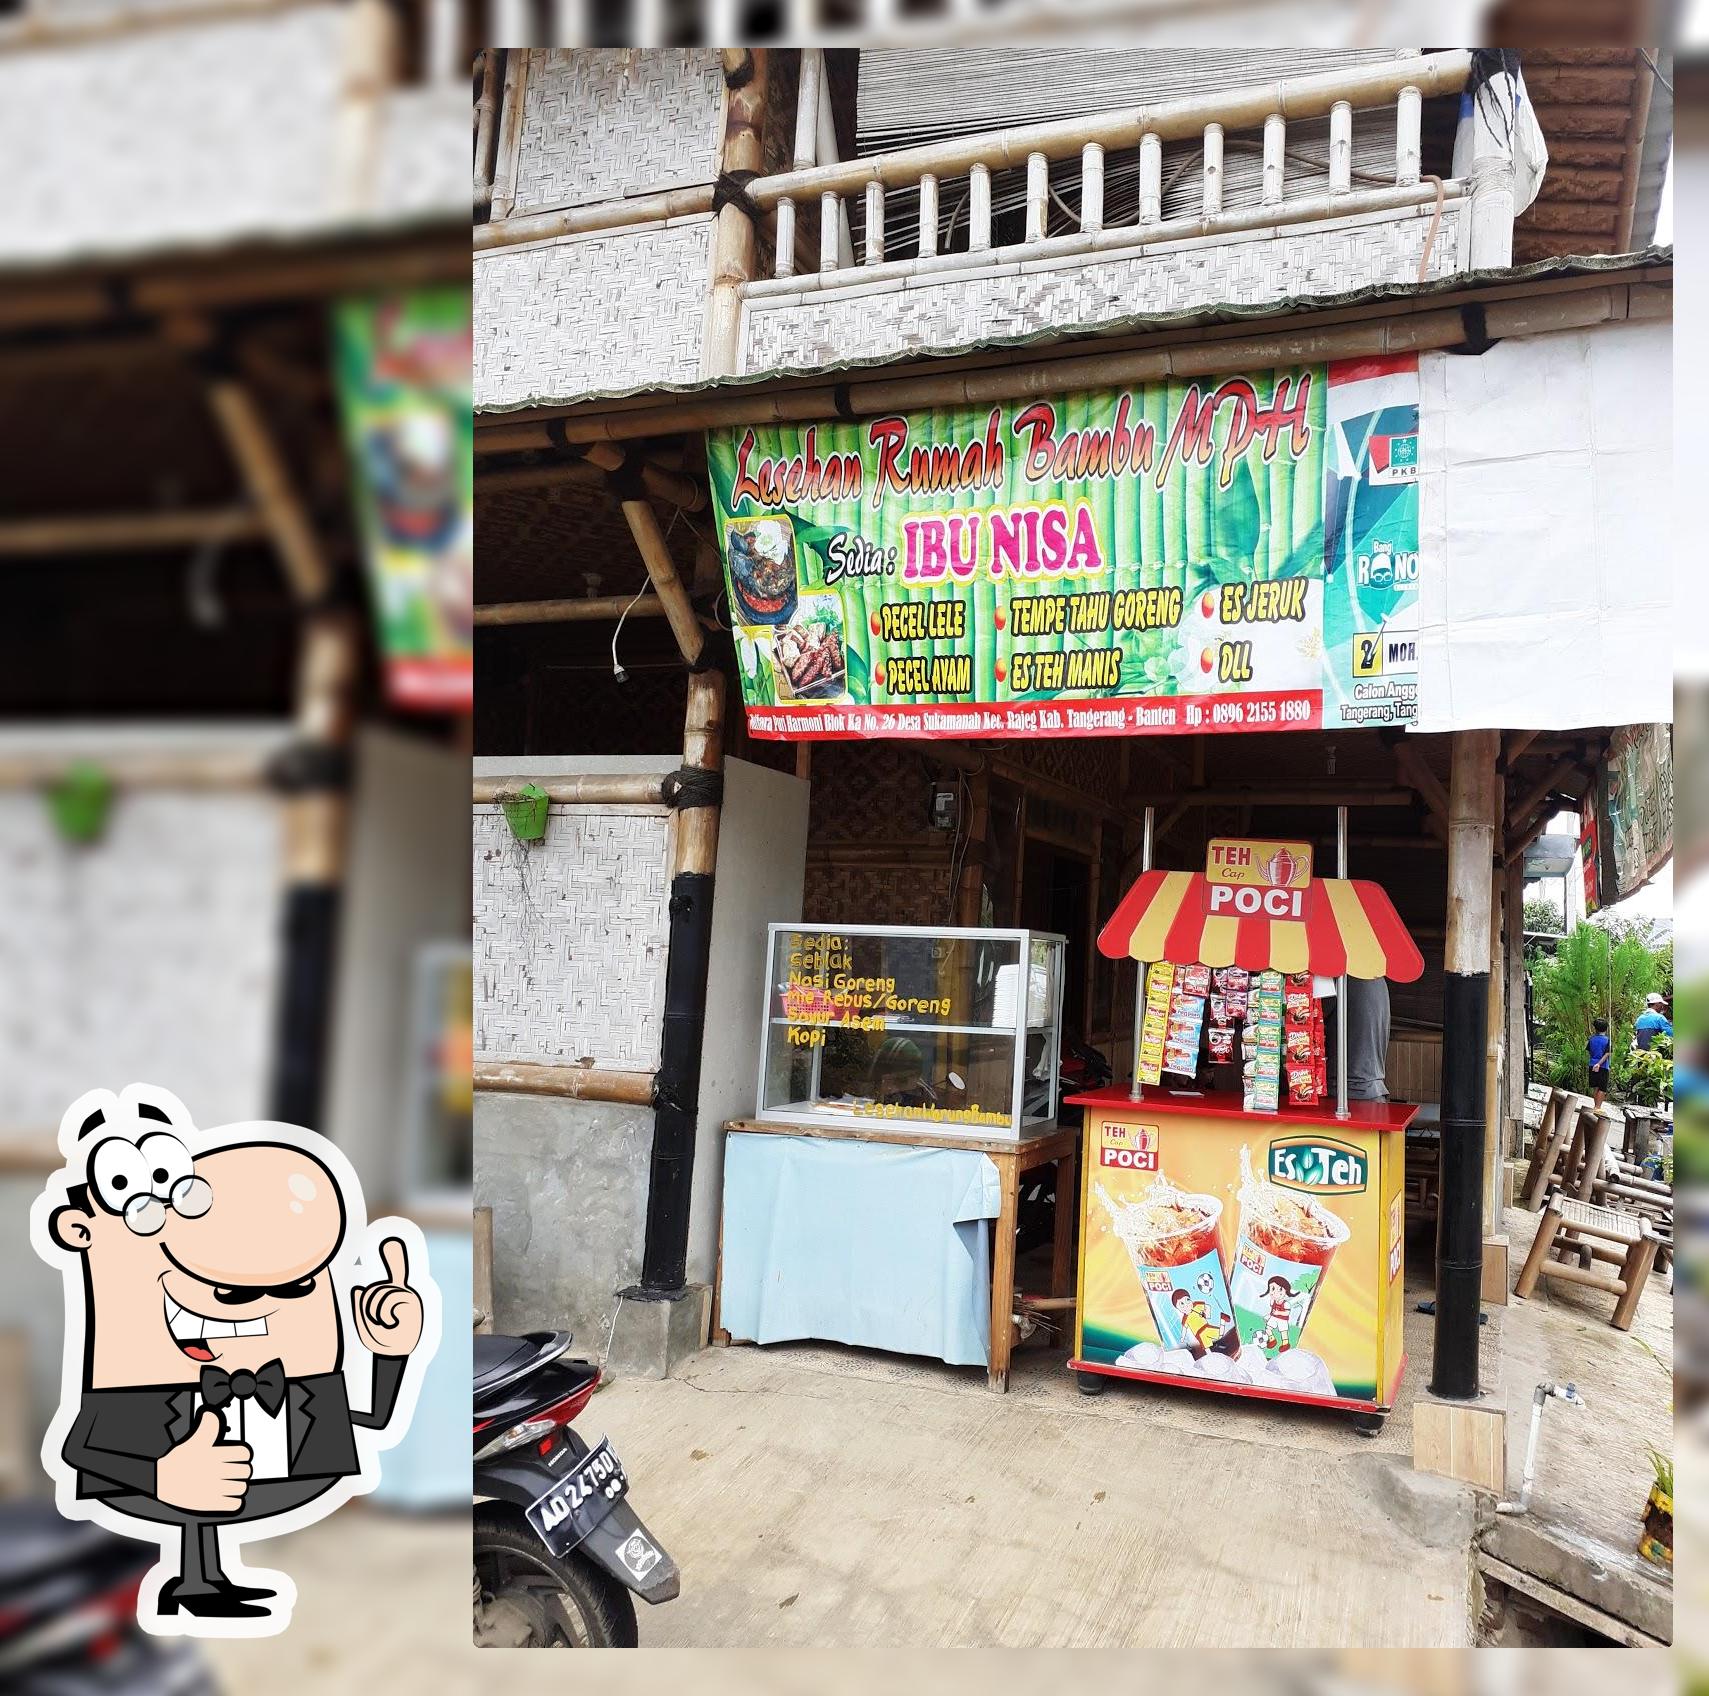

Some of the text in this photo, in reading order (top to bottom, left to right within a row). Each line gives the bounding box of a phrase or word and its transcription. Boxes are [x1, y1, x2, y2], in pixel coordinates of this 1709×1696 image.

[731, 373, 1312, 511] Lesehan Rumah Bambu MPH
[903, 507, 1102, 579] IBU NISA
[1373, 540, 1393, 554] Bang
[825, 531, 898, 585] Sedia:
[1011, 586, 1182, 635] TEMPE TAHU GORENG
[1220, 577, 1308, 623] ES JERUK
[881, 600, 965, 641] PECEL LELE
[1011, 648, 1123, 691] ES TEH MANIS
[1219, 643, 1252, 682] DLL
[887, 655, 972, 694] PECEL AYAM
[1354, 684, 1386, 700] Calon
[786, 714, 823, 732] Harmoni
[824, 713, 845, 731] Blok
[864, 714, 879, 730] No.
[882, 714, 895, 730] 26
[897, 713, 921, 730] Desa
[923, 712, 980, 730] Sukamanah
[1007, 710, 1037, 731] Rajeg
[1039, 709, 1064, 729] Kab.
[1067, 708, 1125, 730] Tangerang
[1136, 706, 1176, 726] Banten
[1212, 703, 1243, 723] 0896
[1246, 701, 1276, 723] 2155
[1279, 700, 1311, 722] 1880
[1341, 703, 1393, 723] Tangerang,
[1212, 846, 1251, 866] TEH
[1221, 868, 1245, 880] Cap
[1210, 885, 1302, 917] POCI
[790, 951, 853, 970] Seblak
[789, 971, 896, 993] Nasi Goreng
[841, 1010, 886, 1031] Asem
[787, 1025, 827, 1047] Kopi
[1104, 1126, 1126, 1138] TEH
[1104, 1149, 1154, 1169] POCI
[1274, 1148, 1362, 1185] Es Teh
[1241, 1256, 1264, 1275] POCI
[1149, 1282, 1173, 1291] POCI
[548, 1447, 568, 1467] HONDA
